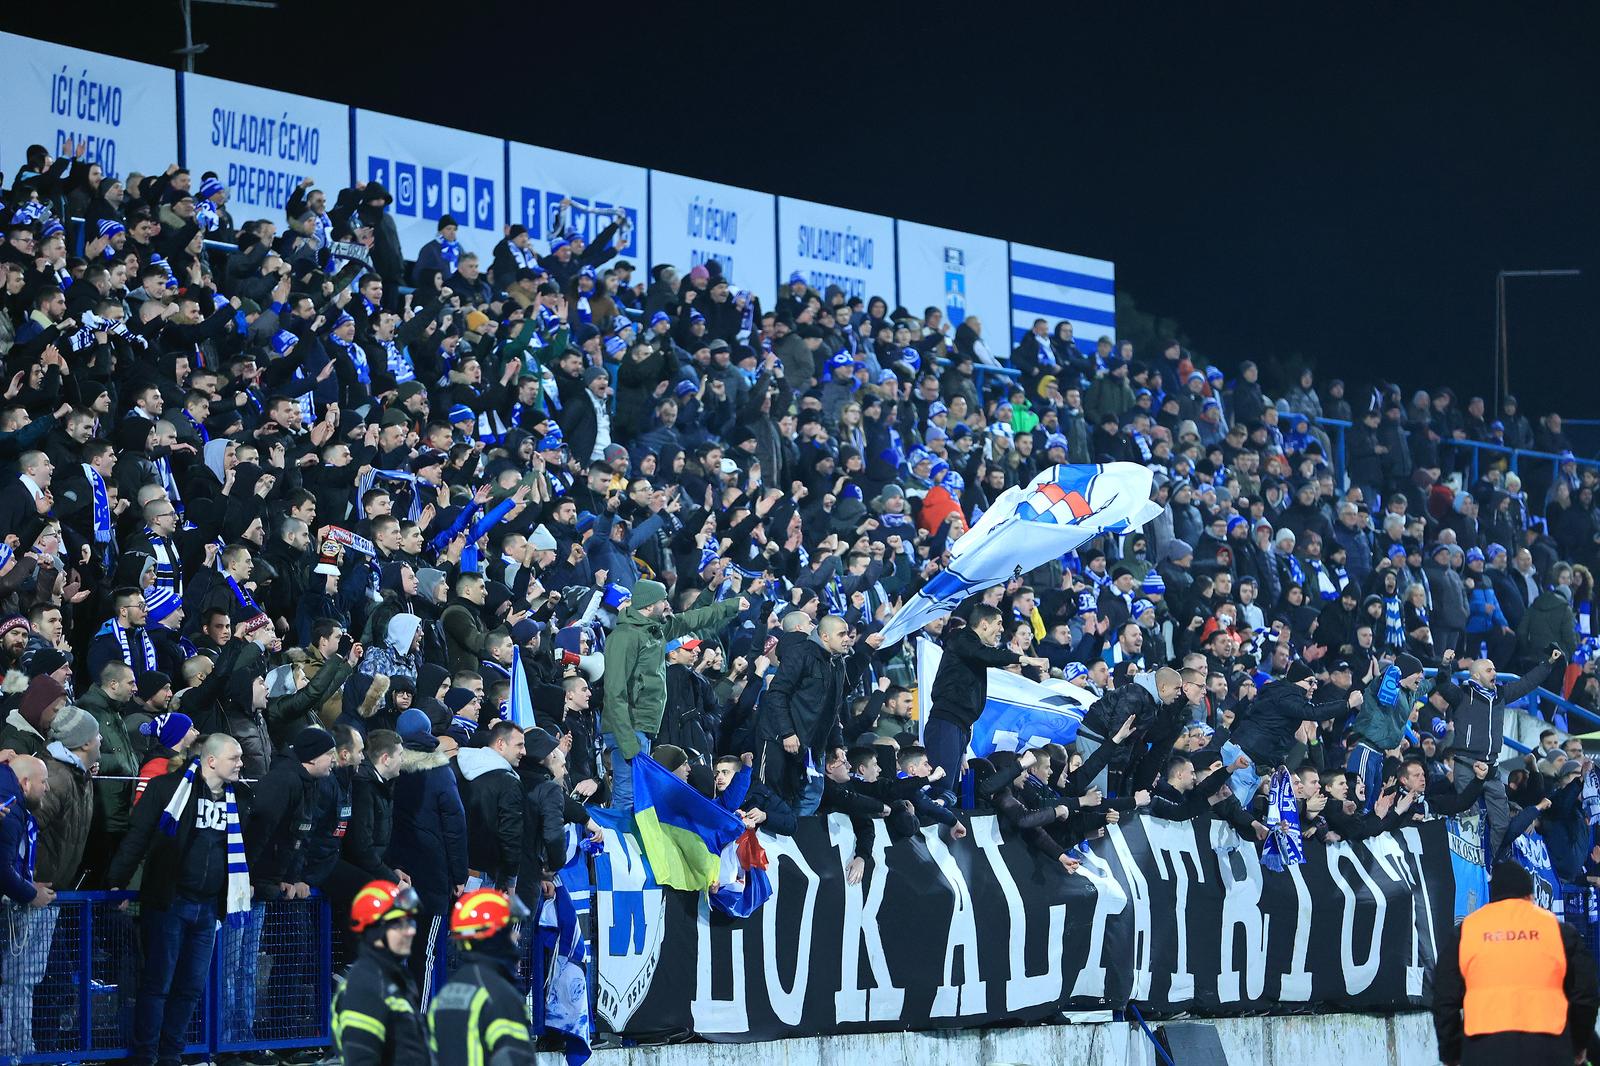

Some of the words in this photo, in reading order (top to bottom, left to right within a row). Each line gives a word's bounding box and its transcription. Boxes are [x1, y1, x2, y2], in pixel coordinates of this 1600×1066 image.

[51, 65, 73, 117] IĆI
[77, 69, 122, 127] ĆEMO
[211, 107, 276, 157] SVLADAT
[278, 111, 320, 165] ĆEMO
[687, 195, 704, 238] IĆI
[705, 198, 738, 244] ĆEMO
[798, 225, 842, 264] SVLADAT
[844, 225, 874, 270] ĆEMO
[1483, 929, 1541, 943] REDAR
